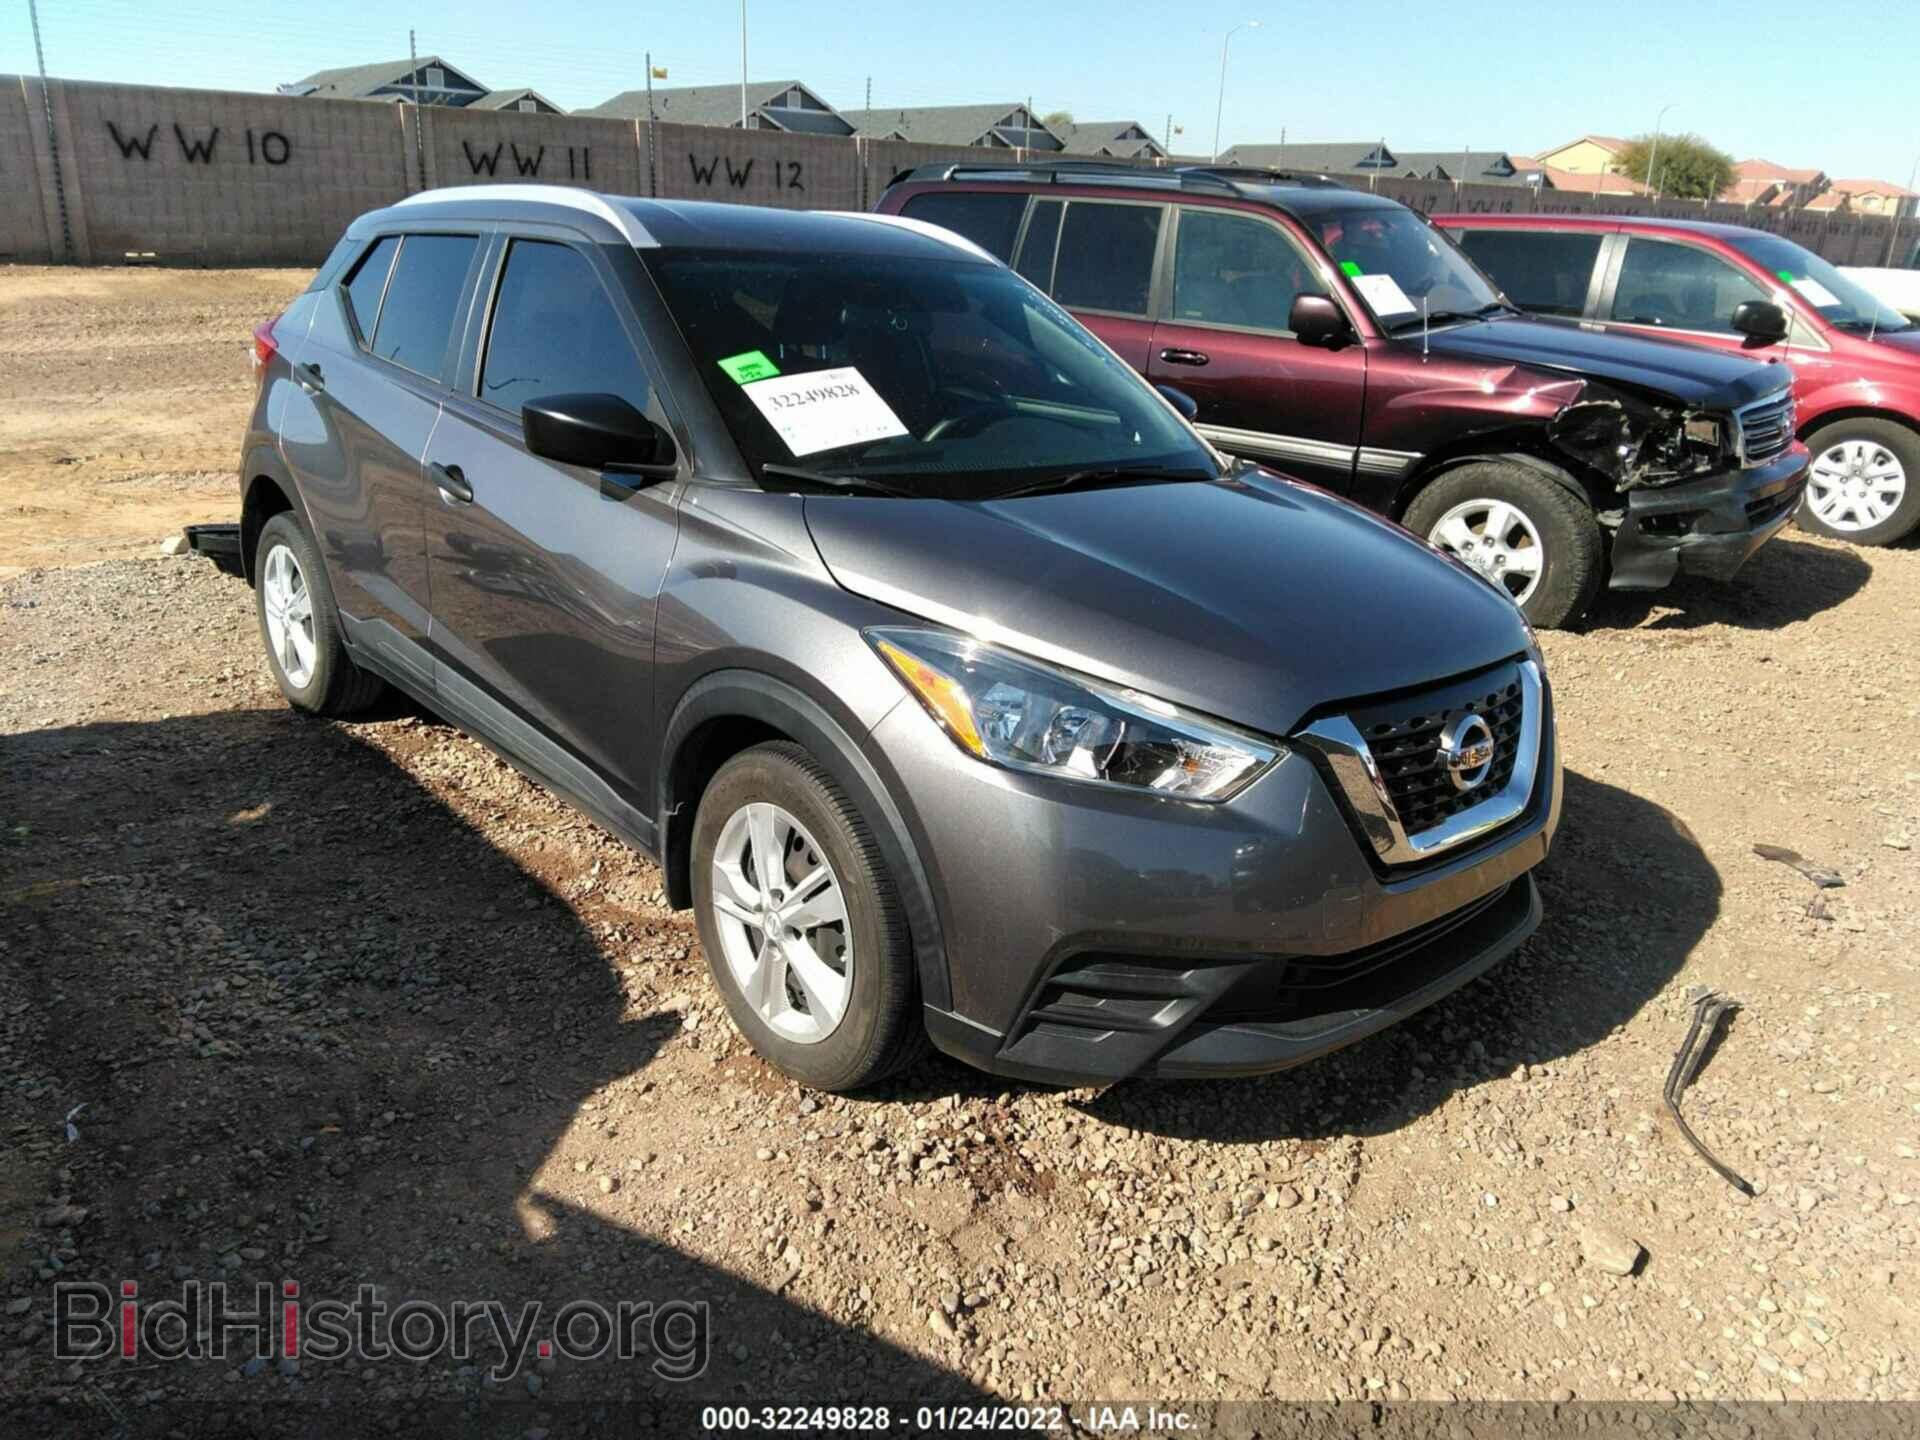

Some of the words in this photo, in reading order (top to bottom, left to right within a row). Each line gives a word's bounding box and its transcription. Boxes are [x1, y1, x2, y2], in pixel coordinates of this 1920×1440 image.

[246, 128, 291, 165] 10
[462, 139, 545, 177] WW
[568, 146, 591, 181] 11
[689, 152, 753, 190] WW
[774, 159, 806, 192] 12
[768, 383, 861, 412] 32249828
